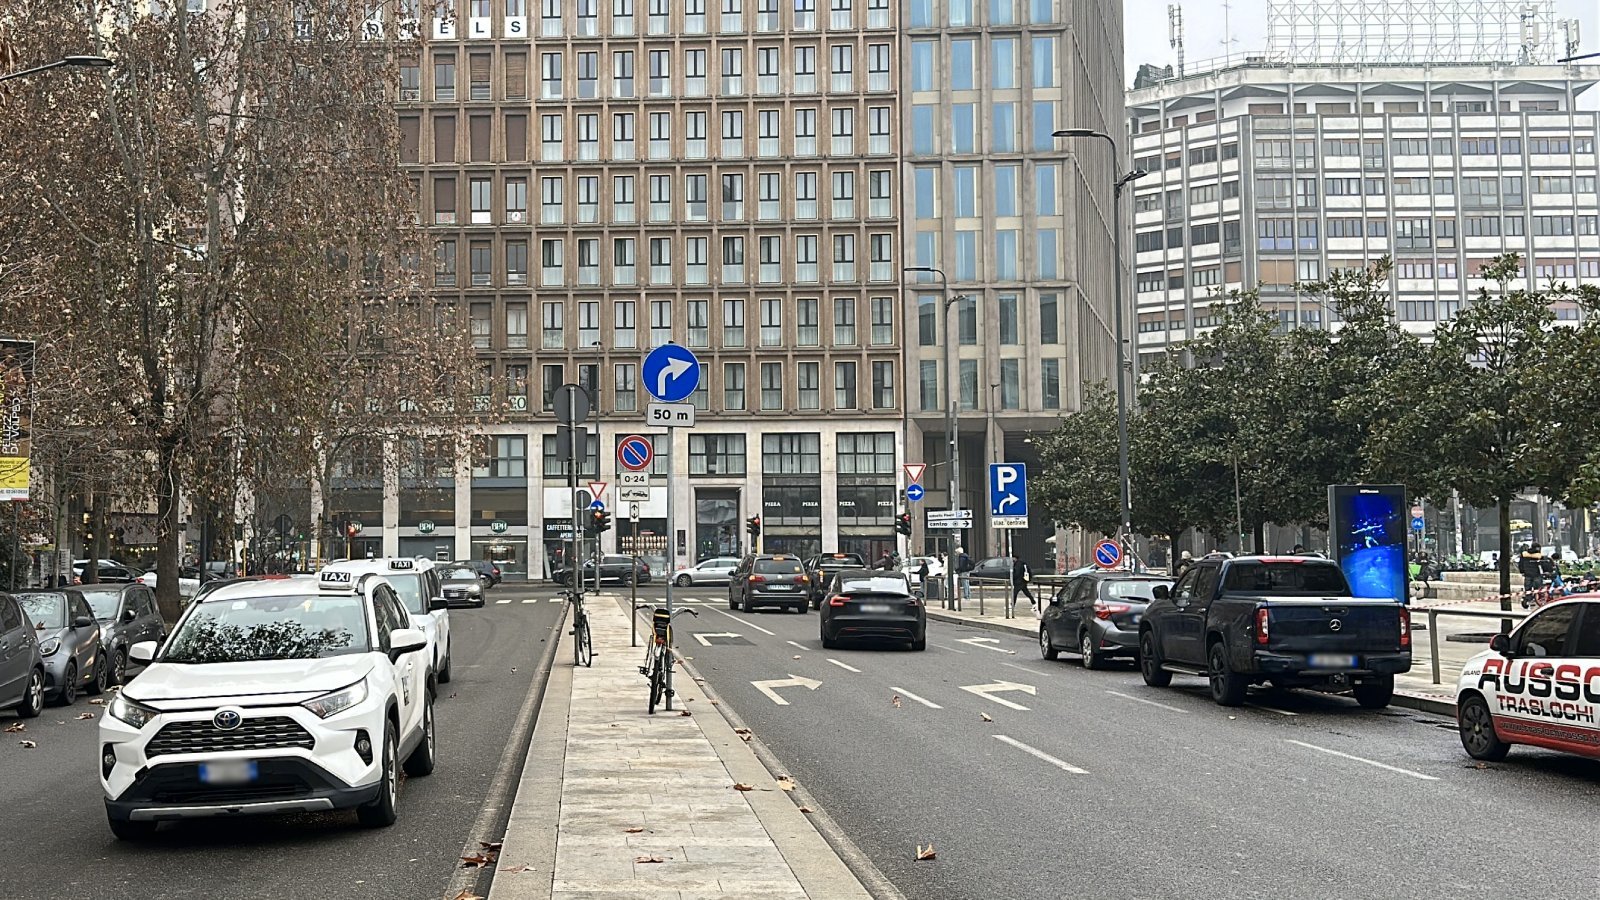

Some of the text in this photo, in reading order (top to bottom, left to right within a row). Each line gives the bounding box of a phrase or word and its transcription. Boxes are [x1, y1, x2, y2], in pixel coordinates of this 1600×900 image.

[653, 409, 689, 420] 50 m
[624, 475, 645, 483] 0-24
[997, 466, 1018, 492] P
[322, 571, 351, 582] TAXI
[1478, 658, 1600, 704] RUSSO
[1497, 695, 1595, 723] TRASLOCHI
